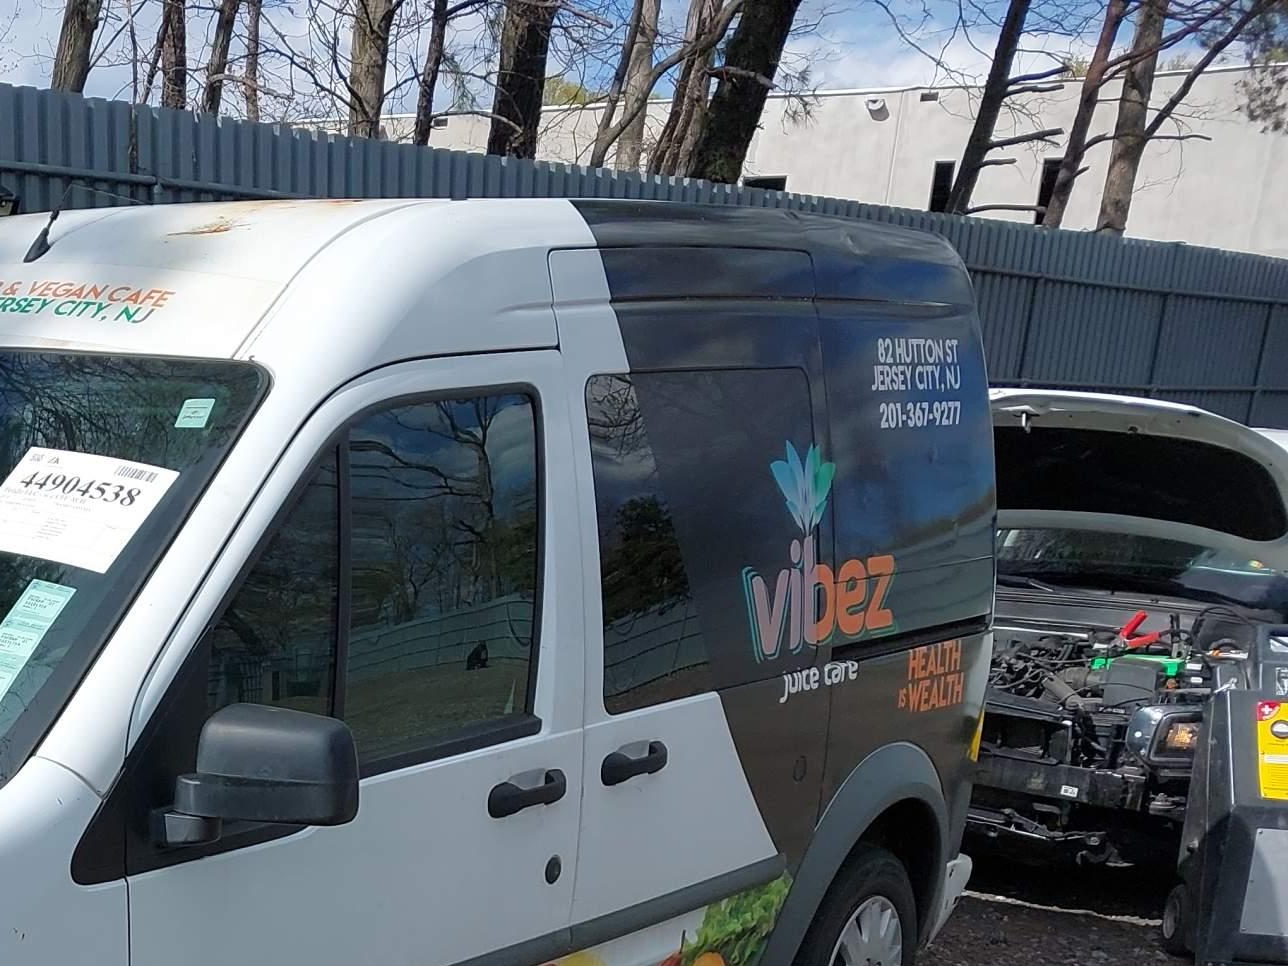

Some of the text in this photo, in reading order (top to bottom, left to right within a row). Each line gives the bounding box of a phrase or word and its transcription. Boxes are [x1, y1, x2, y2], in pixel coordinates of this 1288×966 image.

[2, 281, 22, 296] &
[28, 281, 109, 301] VEGAN
[108, 286, 176, 308] CAFE
[54, 300, 111, 321] CITY,
[114, 305, 155, 323] NJ
[878, 338, 958, 363] 82 HUTTON ST
[872, 365, 961, 392] JERSEY CITY, NJ
[879, 401, 961, 428] 201-367-9277
[20, 471, 142, 506] 44904538
[744, 535, 897, 658] vibez
[908, 639, 962, 680] HEALTH
[779, 667, 820, 703] juice
[908, 672, 964, 711] WEALTH
